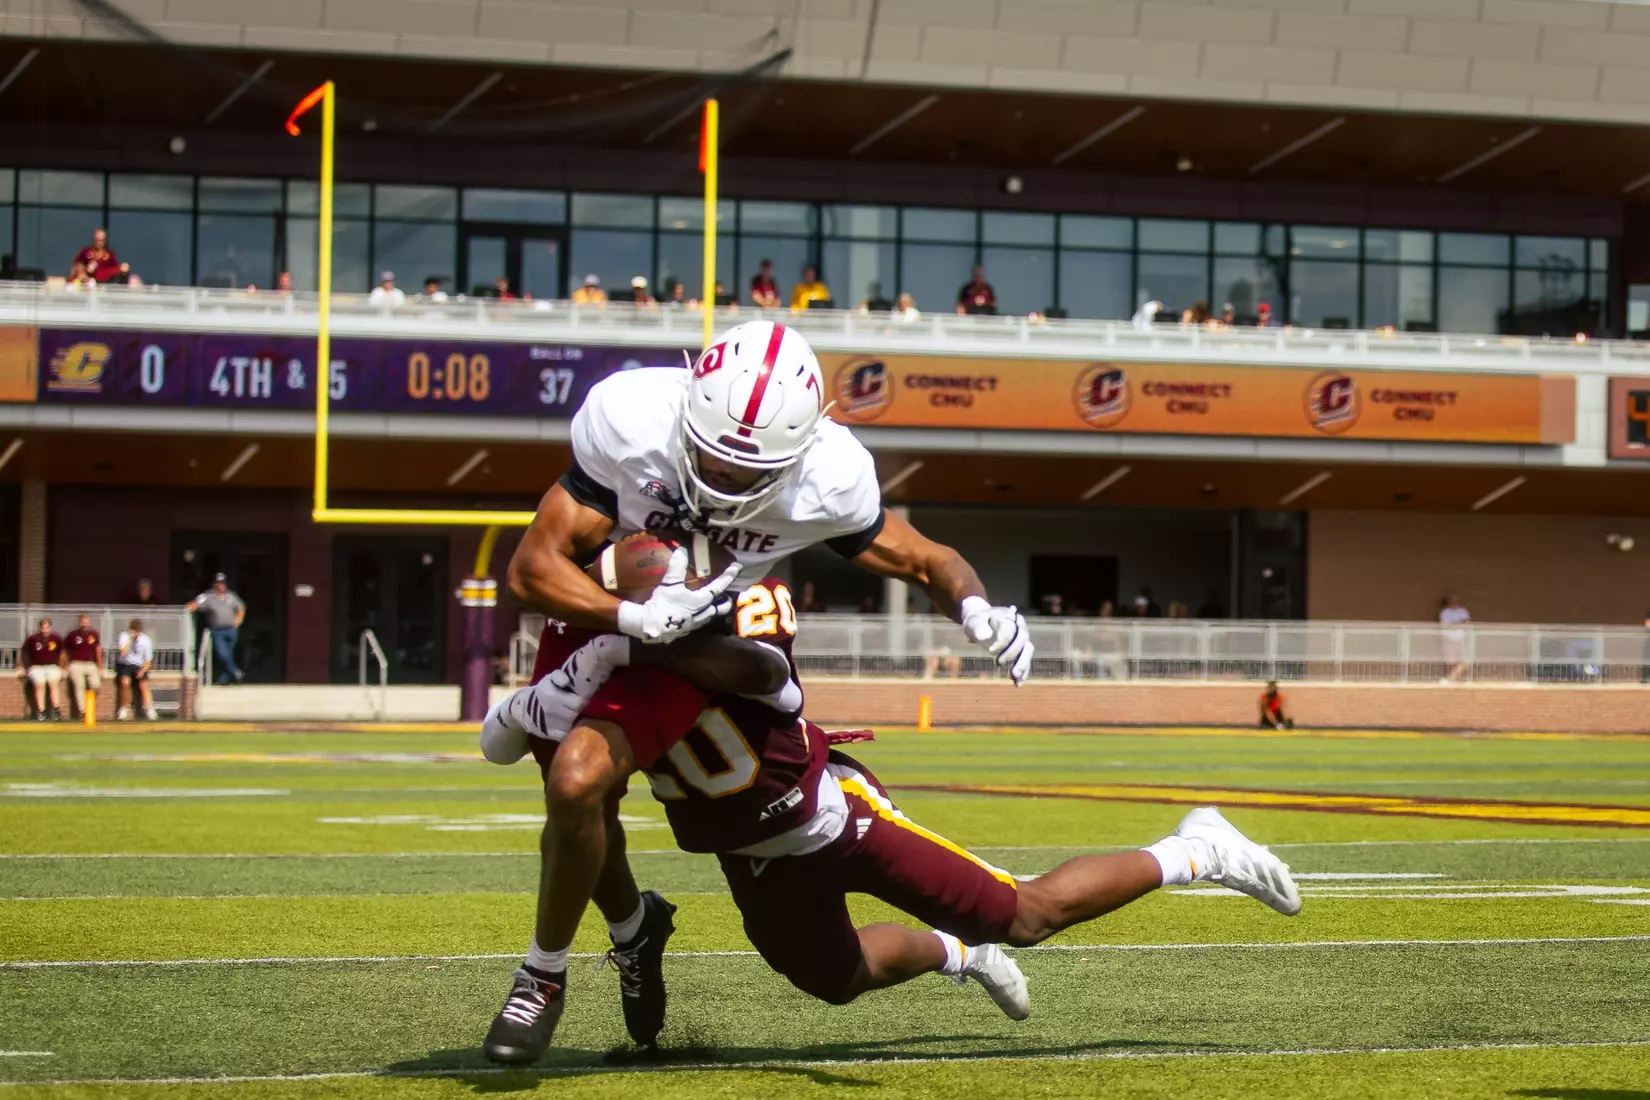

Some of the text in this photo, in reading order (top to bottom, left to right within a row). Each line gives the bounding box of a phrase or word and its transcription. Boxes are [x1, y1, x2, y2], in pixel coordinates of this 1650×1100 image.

[140, 344, 165, 394] 0
[209, 356, 348, 400] 4TH & 5
[407, 352, 491, 401] 0:08
[904, 373, 997, 392] CONNECT
[538, 367, 576, 405] 37
[929, 392, 974, 408] CMU
[1141, 381, 1232, 399] CONNECT
[1370, 388, 1458, 407] CONNECT
[1165, 399, 1209, 415] CMU
[1393, 405, 1436, 422] CMU
[735, 583, 798, 639] 20
[650, 706, 761, 800] 0
